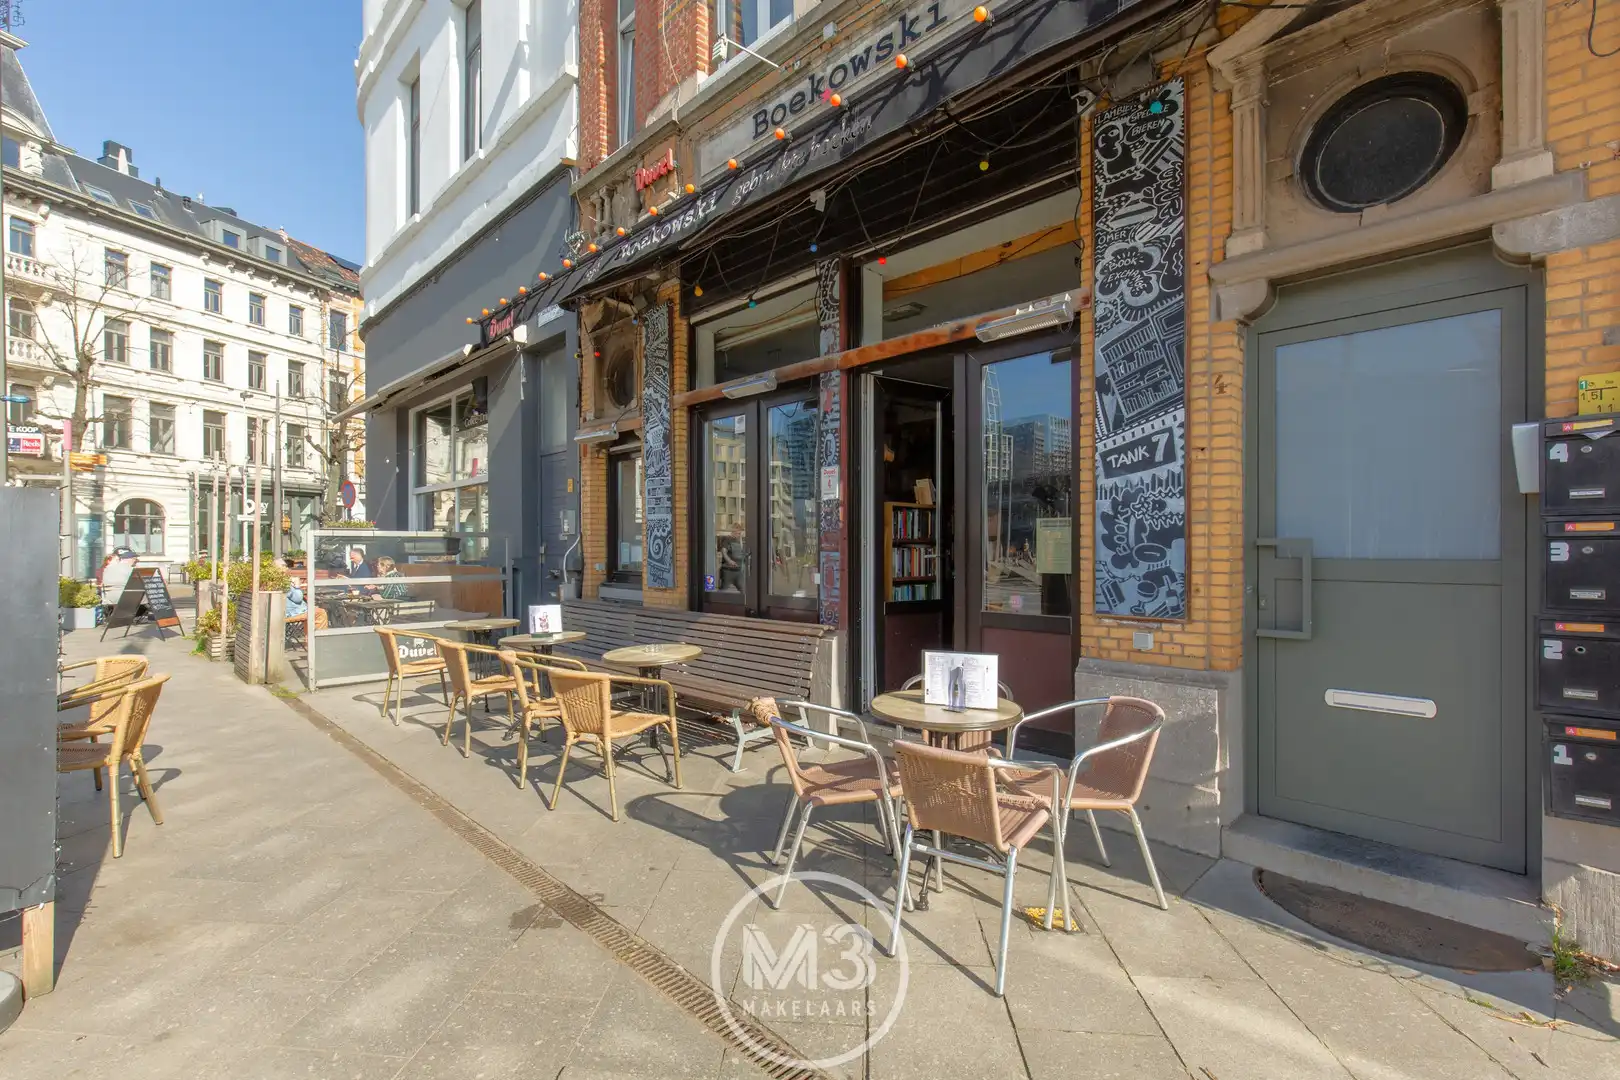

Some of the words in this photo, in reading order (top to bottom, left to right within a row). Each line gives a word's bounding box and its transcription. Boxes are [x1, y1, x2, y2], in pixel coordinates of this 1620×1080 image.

[753, 2, 948, 140] Boekowski
[635, 147, 674, 192] Duvel
[1098, 230, 1127, 245] OMER
[1109, 257, 1138, 271] BOOK
[1106, 445, 1150, 469] TANK
[1151, 432, 1170, 463] 7
[1549, 443, 1569, 463] 4
[1113, 505, 1132, 556] BOOKS
[1550, 542, 1570, 562] 3
[1543, 639, 1563, 660] 2
[1553, 744, 1573, 766] 1
